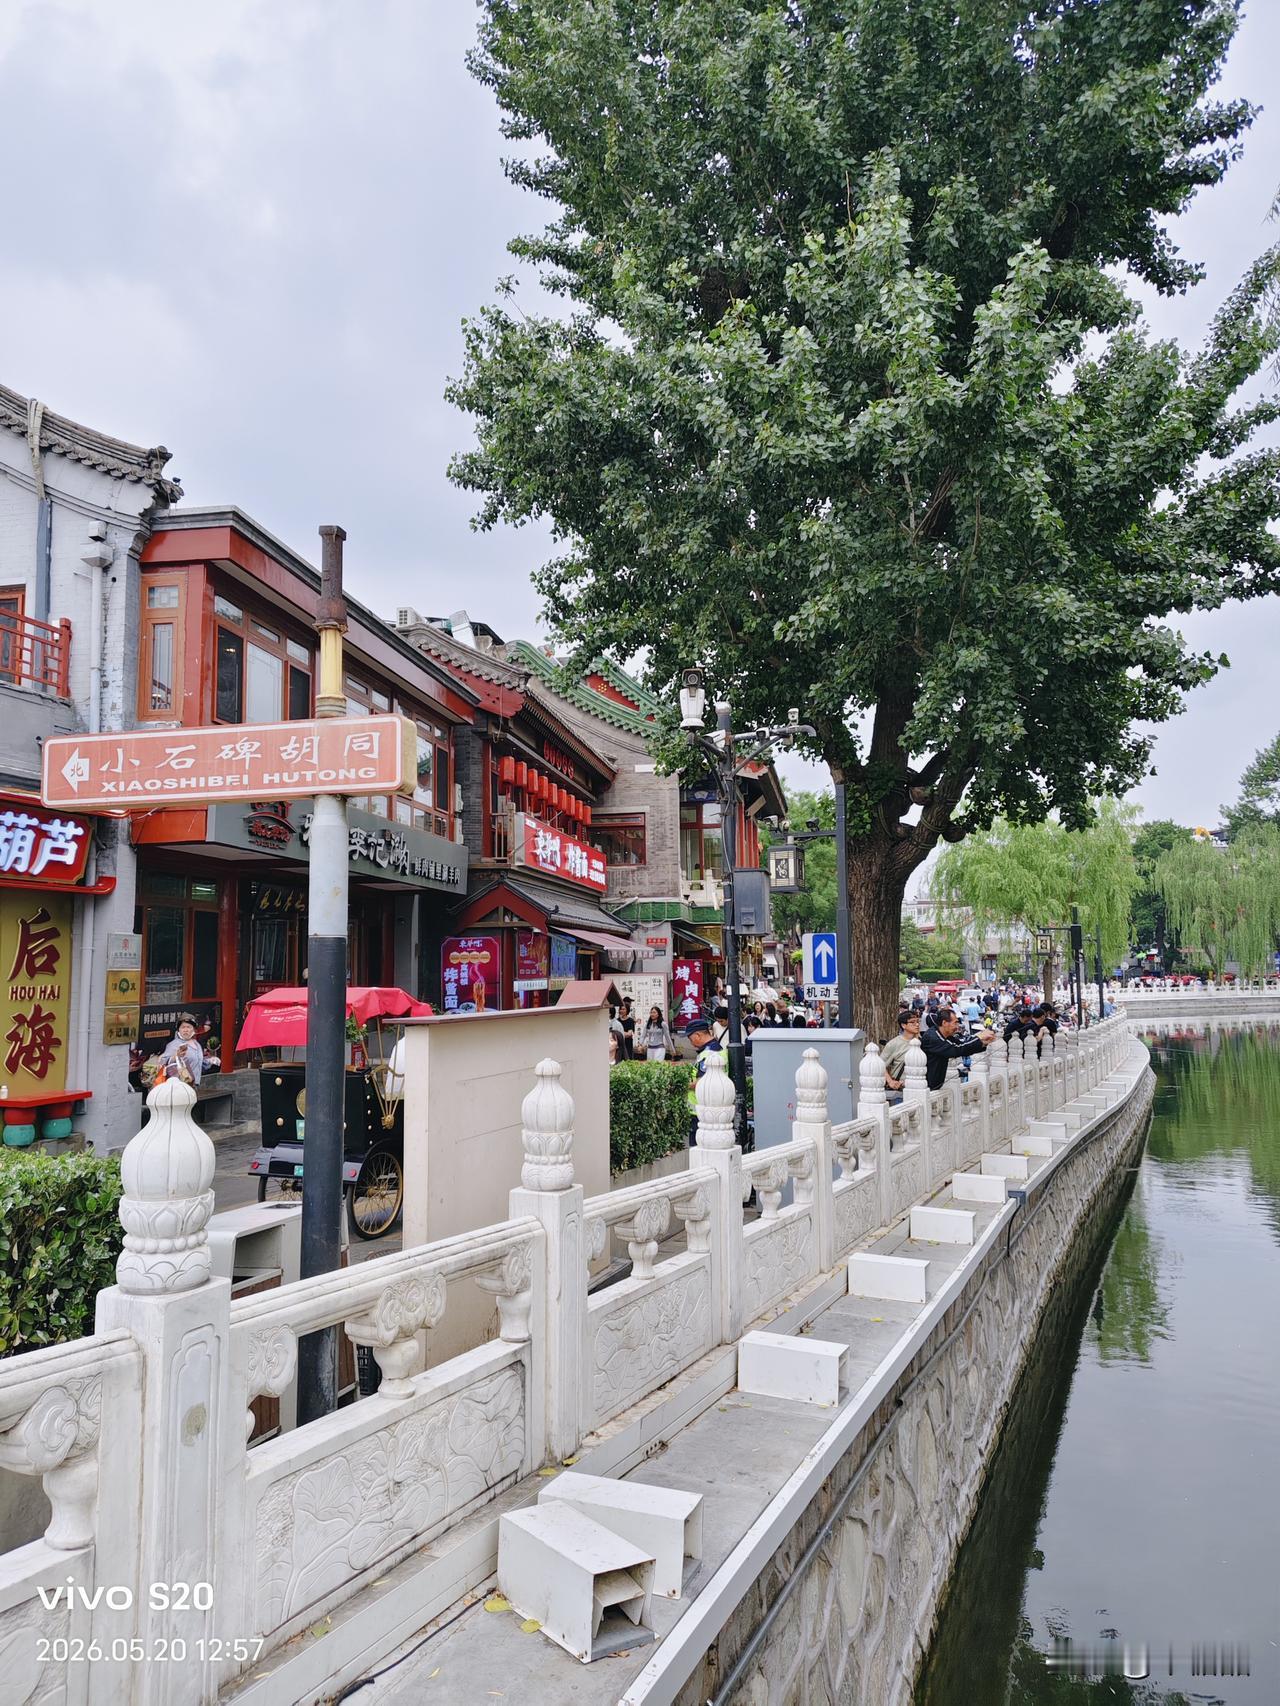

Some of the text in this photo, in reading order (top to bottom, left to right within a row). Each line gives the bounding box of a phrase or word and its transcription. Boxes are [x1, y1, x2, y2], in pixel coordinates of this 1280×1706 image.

[100, 731, 380, 773] 小石碑胡同
[101, 766, 377, 793] XIAOSHIBEI HUTONG
[8, 907, 61, 981] 后
[9, 985, 61, 1000] HOU HAI
[675, 965, 699, 1019] 烤肉季
[5, 1003, 62, 1080] 海
